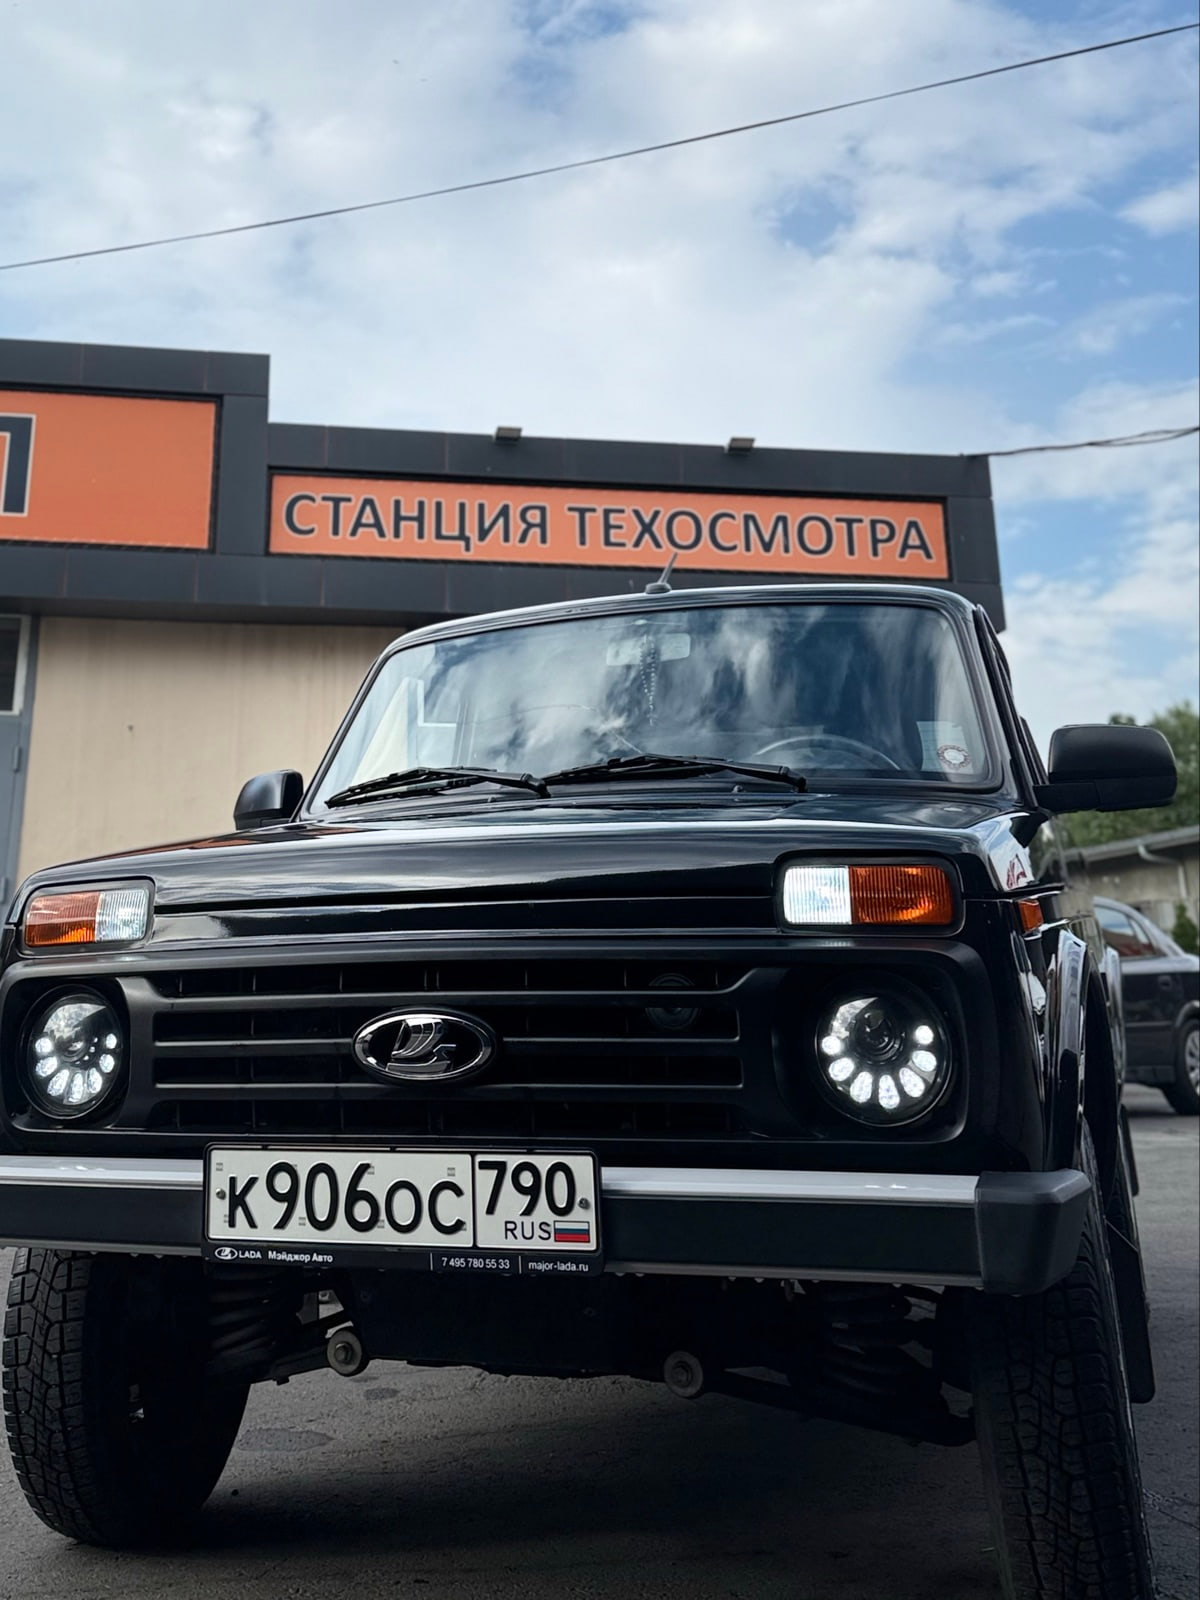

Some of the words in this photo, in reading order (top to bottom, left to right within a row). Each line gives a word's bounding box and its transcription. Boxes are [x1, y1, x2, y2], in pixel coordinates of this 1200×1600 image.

[283, 492, 549, 554] СТАНЦИЯ
[566, 504, 935, 562] ТЕХОСМОТРА
[477, 1159, 577, 1218] 790
[504, 1220, 552, 1241] RUS
[238, 1250, 262, 1260] LADA
[267, 1250, 311, 1263] Мэйджор
[311, 1252, 334, 1263] Авто
[441, 1257, 448, 1267] 7
[448, 1257, 466, 1268] 495
[467, 1258, 485, 1269] 780
[485, 1258, 497, 1269] 55
[498, 1259, 511, 1270] 33
[528, 1261, 590, 1273] major-lada.ru
